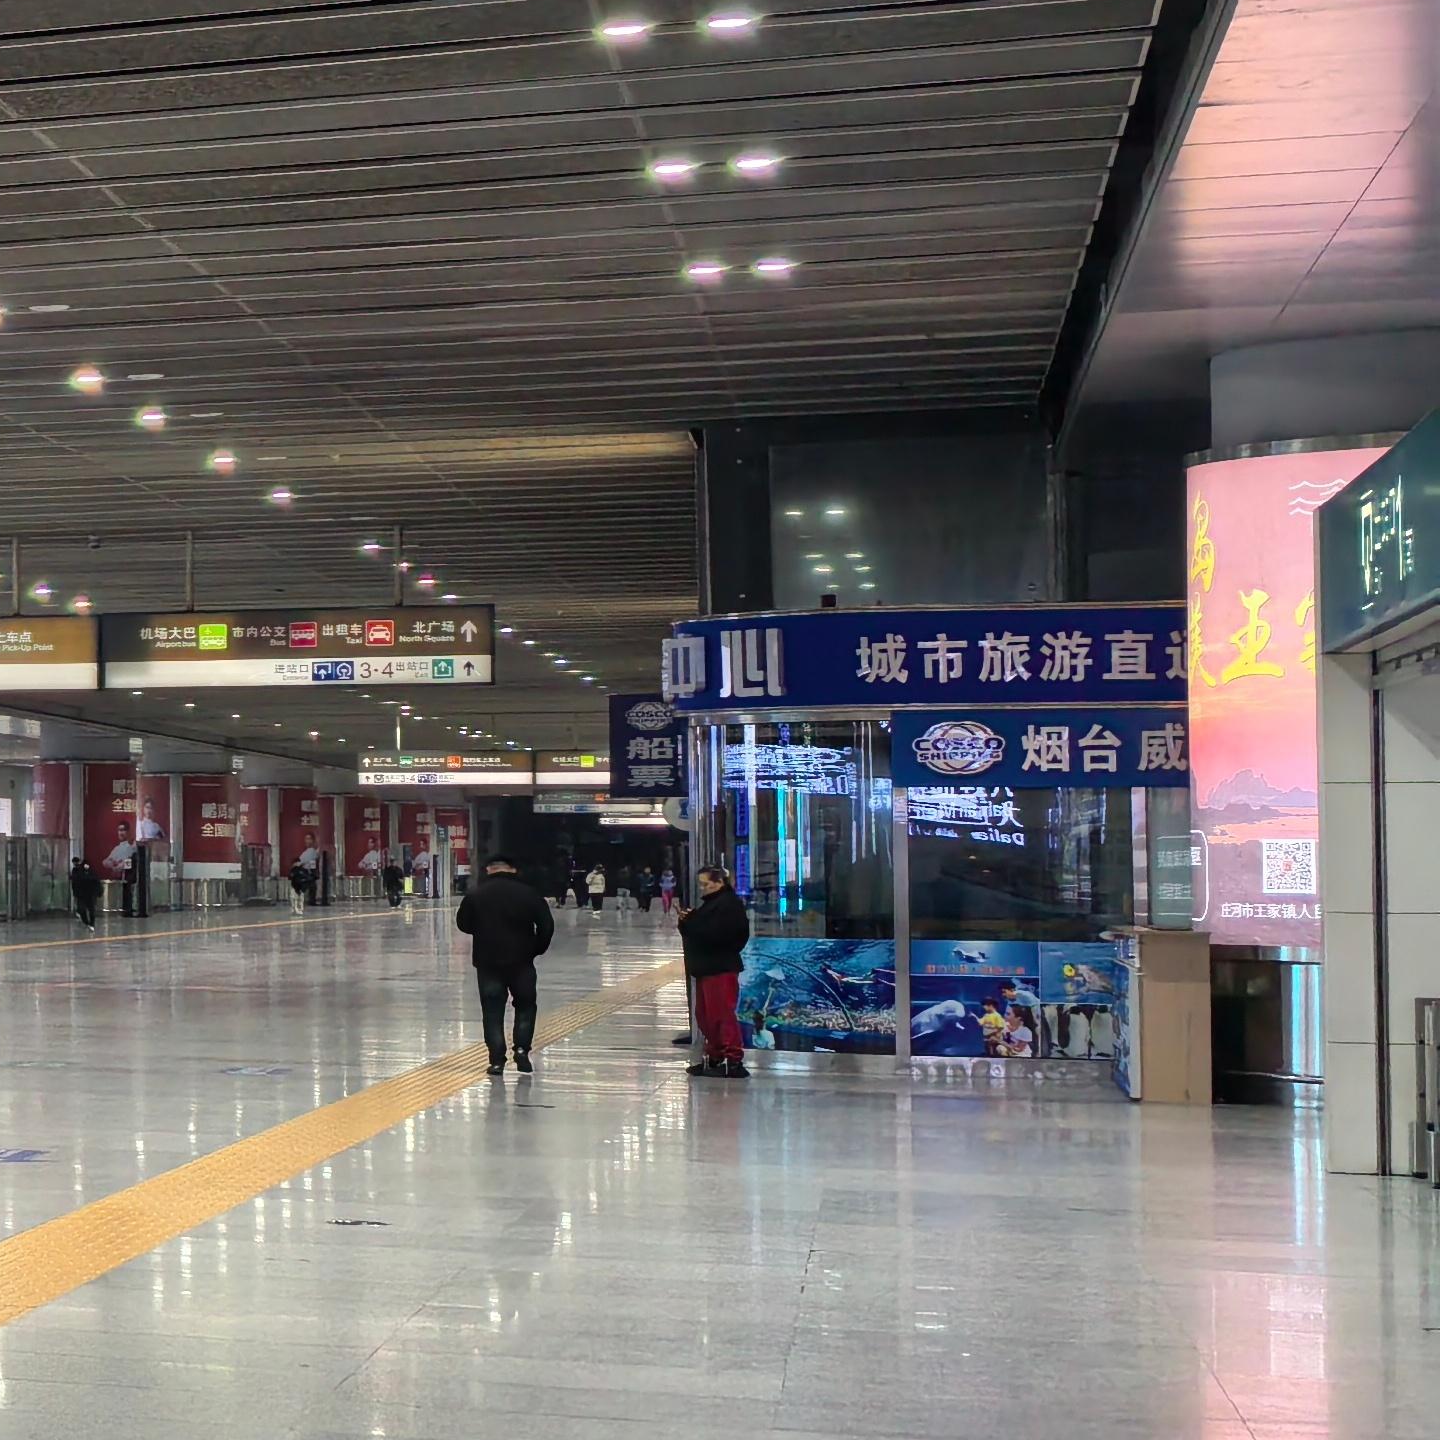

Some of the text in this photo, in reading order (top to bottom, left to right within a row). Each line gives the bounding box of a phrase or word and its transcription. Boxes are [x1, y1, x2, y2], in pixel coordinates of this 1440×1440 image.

[232, 626, 287, 638] 市内公交
[322, 624, 363, 636] 出租车
[412, 620, 456, 633] 北广场
[140, 627, 197, 640] 机场大巴
[398, 633, 456, 643] North Square
[270, 639, 287, 647] Bus
[346, 636, 363, 644] Taxi
[2, 643, 31, 653] Pick-Up
[33, 643, 54, 651] Point
[274, 663, 309, 674] 进站口
[395, 661, 430, 672] 出站口
[661, 627, 788, 702] 中心
[912, 734, 1006, 752] COSCO
[1021, 722, 1189, 773] 烟台威
[626, 735, 675, 788] 船票
